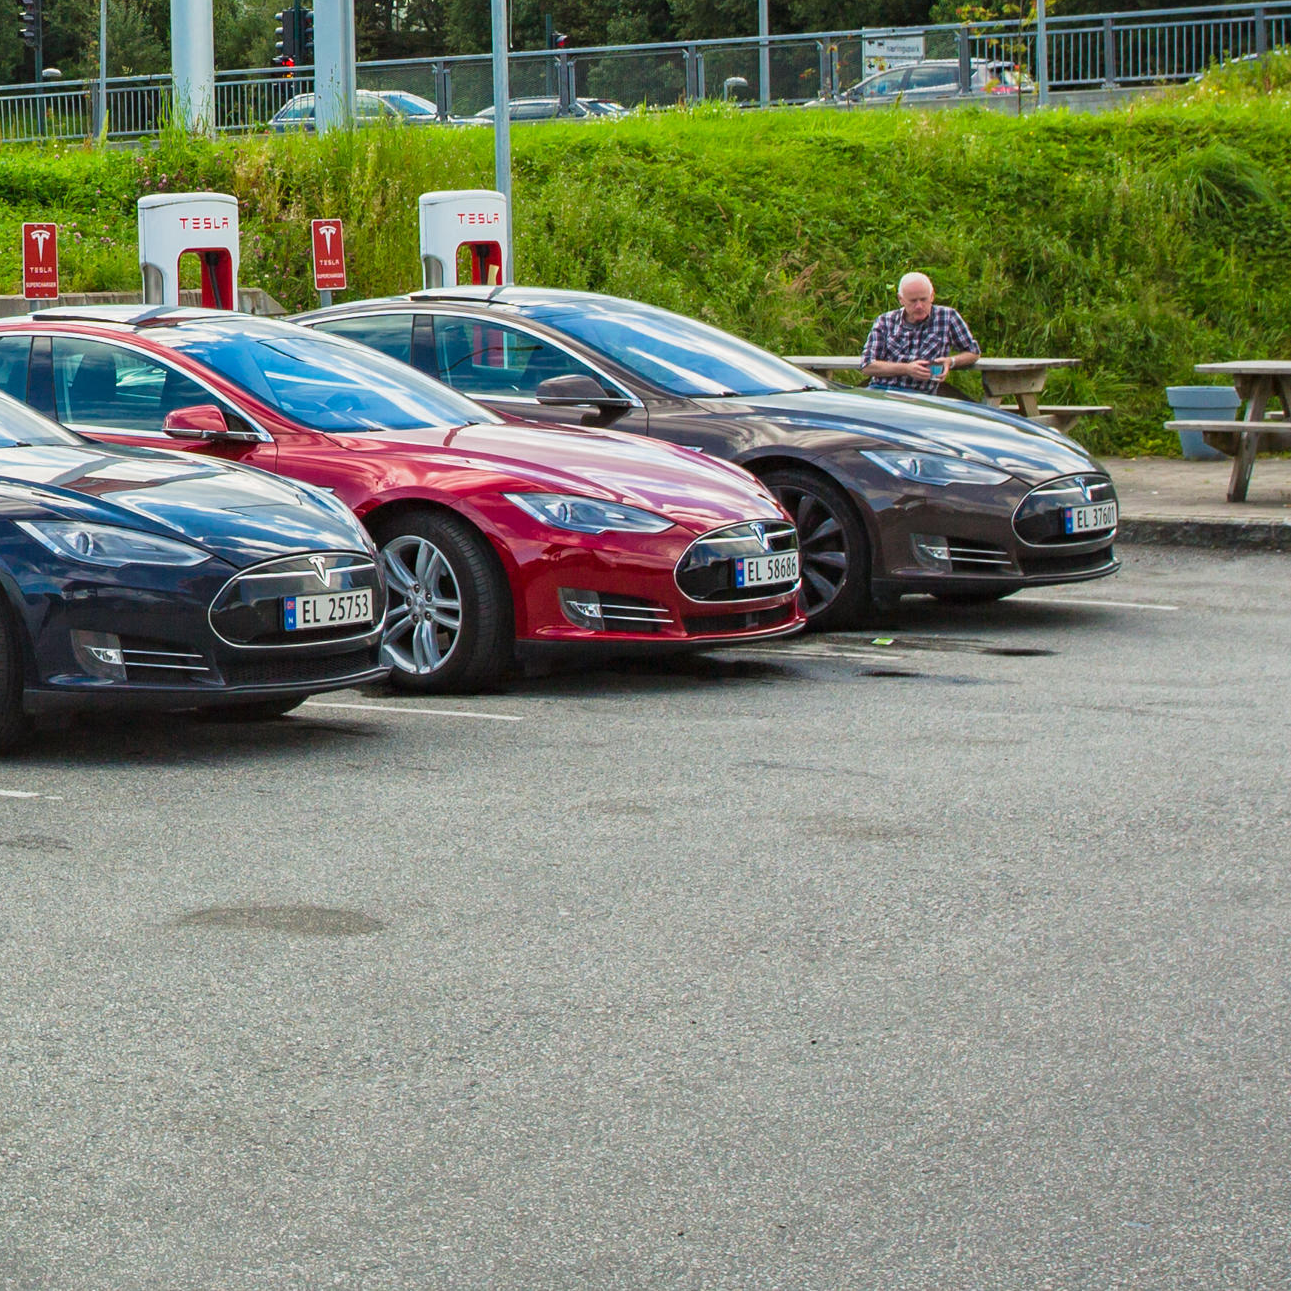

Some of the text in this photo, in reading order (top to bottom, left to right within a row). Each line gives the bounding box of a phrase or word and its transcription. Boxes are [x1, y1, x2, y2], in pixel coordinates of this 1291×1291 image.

[179, 217, 229, 229] TESLA
[457, 213, 499, 224] TESLA
[29, 266, 53, 274] TESLA
[748, 556, 796, 581] EL 58686
[302, 593, 369, 623] EL 25753
